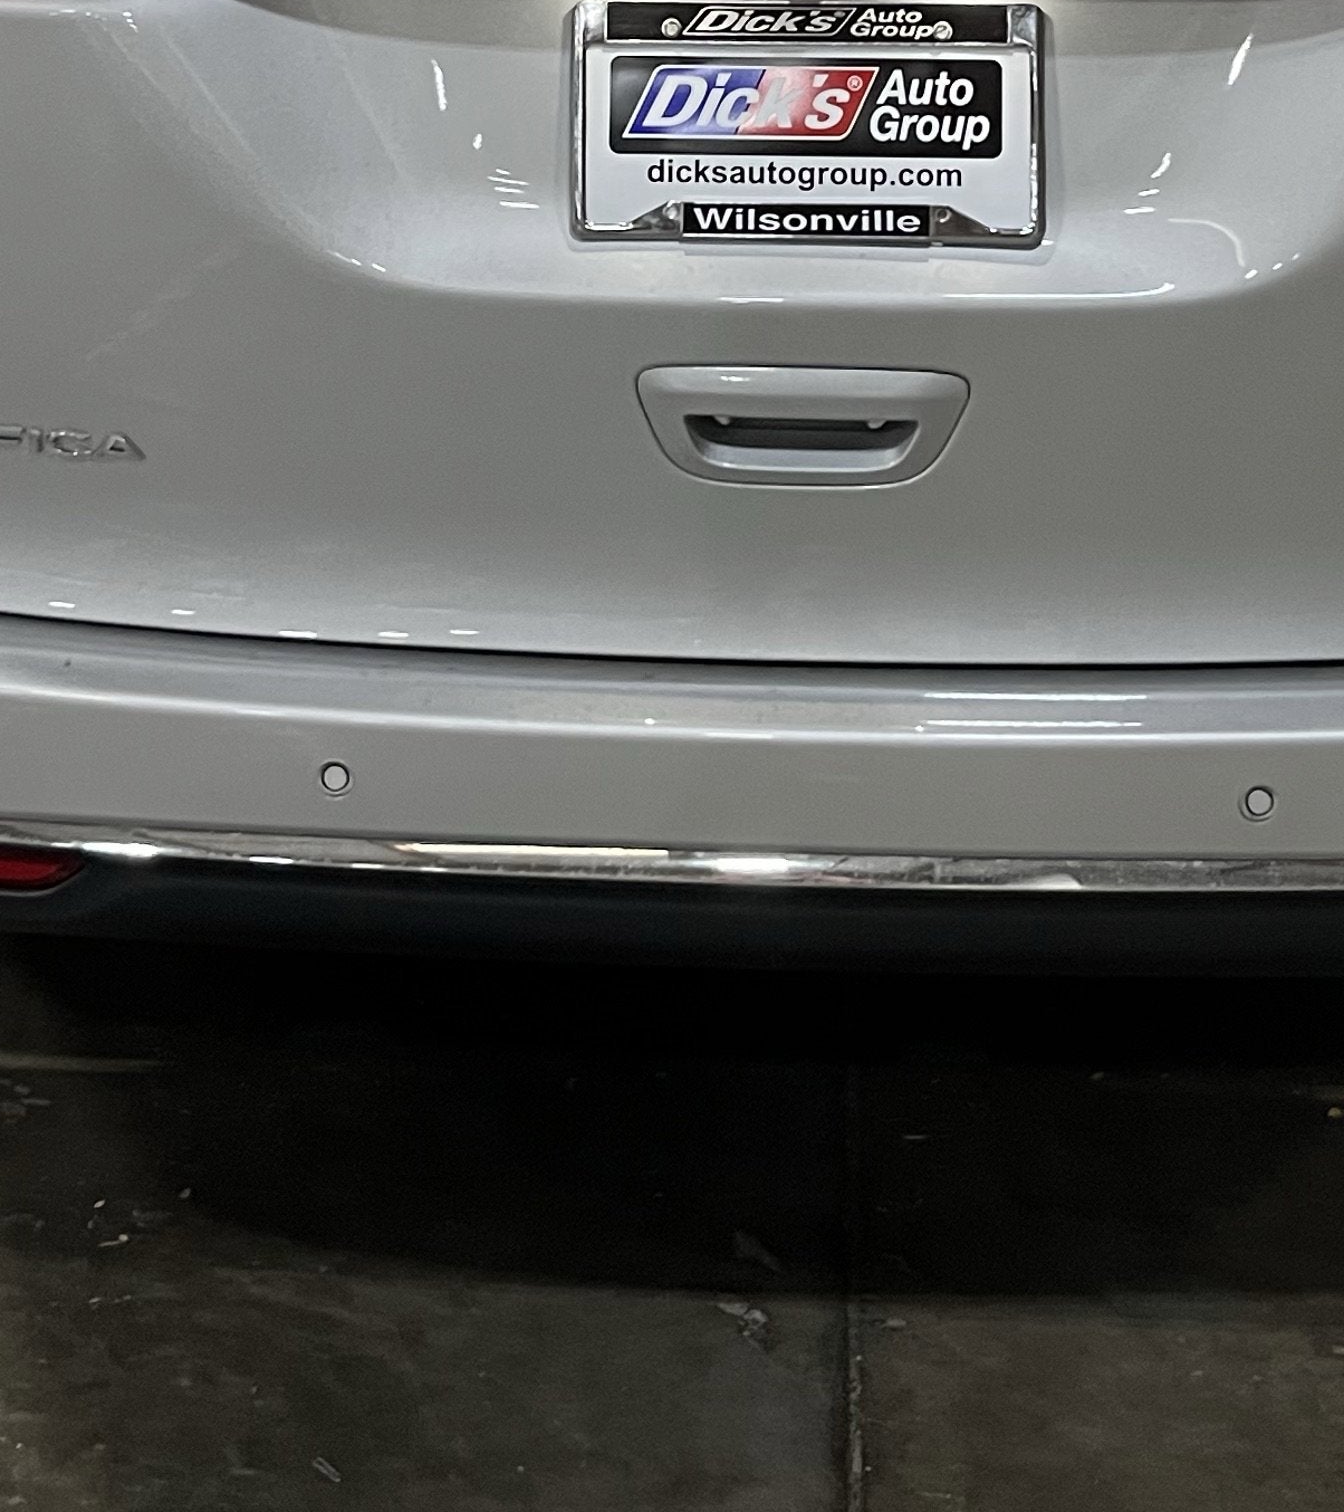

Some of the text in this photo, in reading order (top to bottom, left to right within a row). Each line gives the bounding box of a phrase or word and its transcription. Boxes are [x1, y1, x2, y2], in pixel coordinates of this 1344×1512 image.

[694, 9, 838, 32] Dick's
[850, 22, 933, 39] Group
[856, 7, 923, 24] Auto
[641, 73, 851, 130] Dick's
[876, 69, 974, 107] Auto
[869, 106, 991, 151] Group
[646, 159, 962, 192] dicksautogroup.com
[692, 206, 922, 234] Wilsonville
